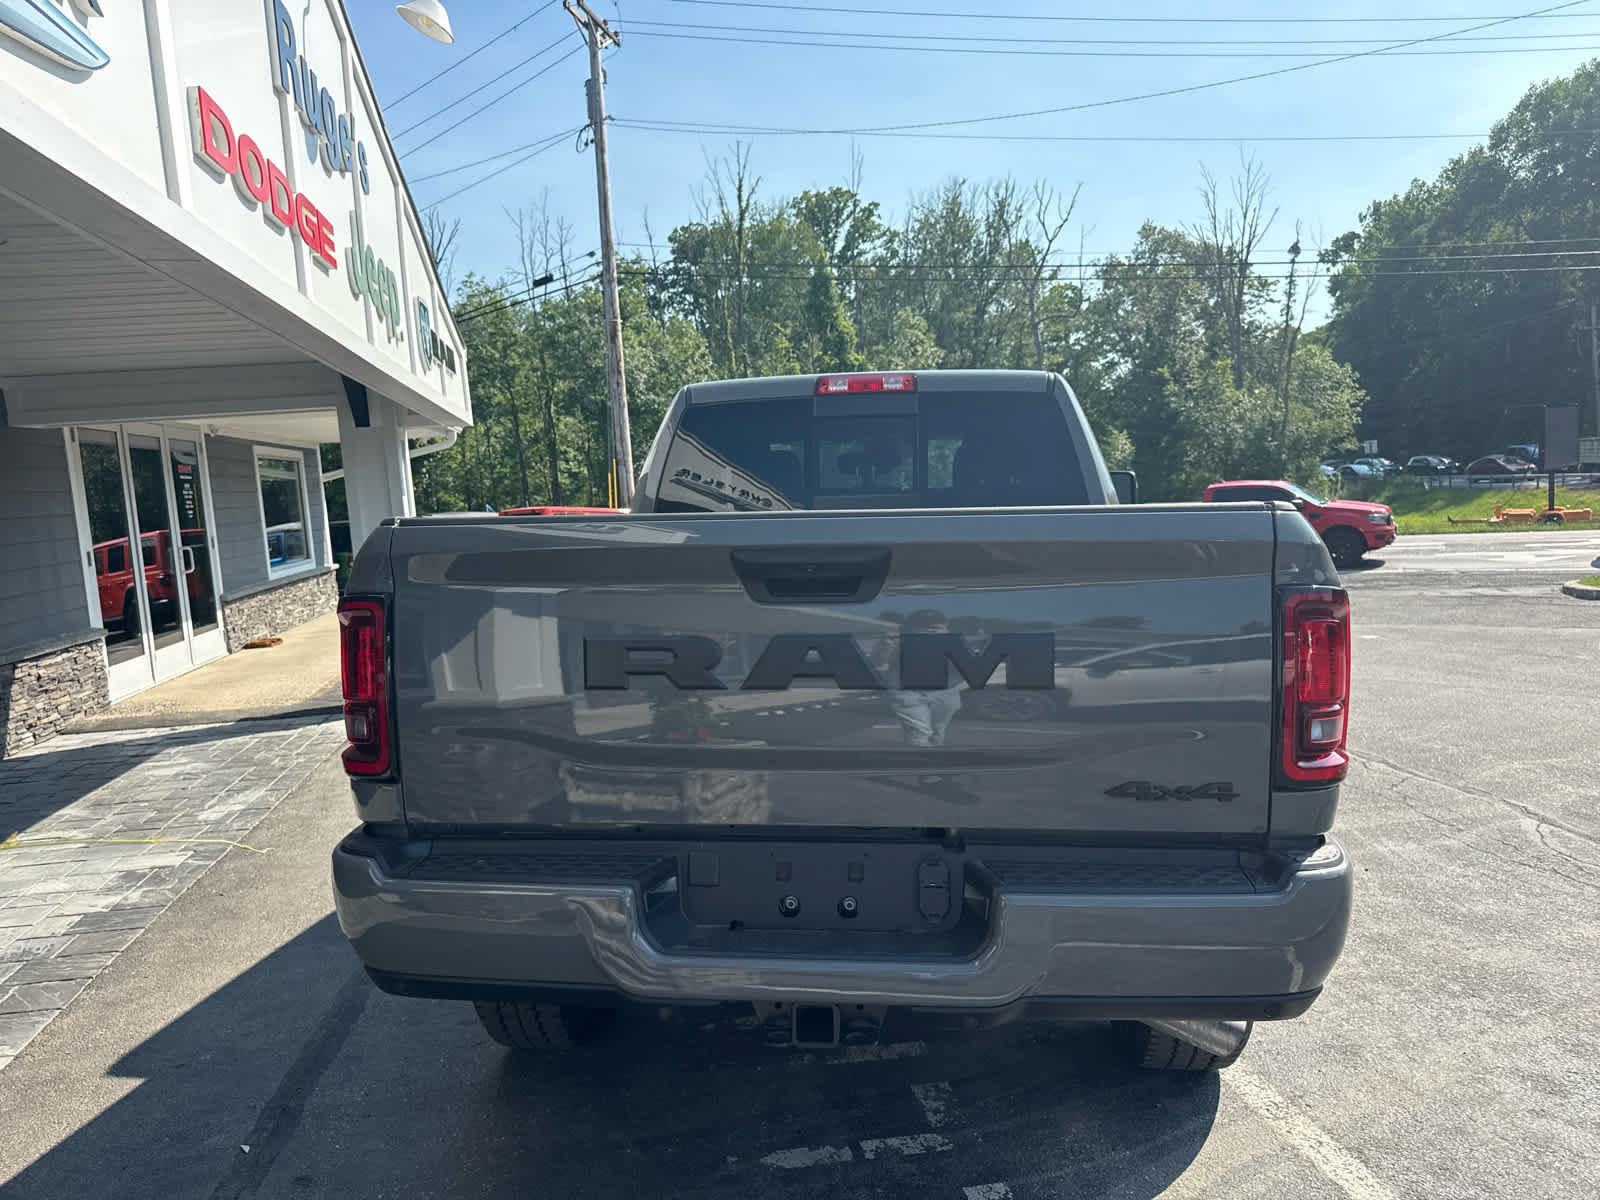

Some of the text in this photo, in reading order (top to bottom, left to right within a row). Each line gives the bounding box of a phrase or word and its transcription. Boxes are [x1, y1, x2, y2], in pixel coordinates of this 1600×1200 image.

[270, 0, 369, 195] Ruge's
[189, 86, 337, 269] DODGE
[583, 632, 1056, 690] RAM
[1103, 780, 1241, 803] 4x4
